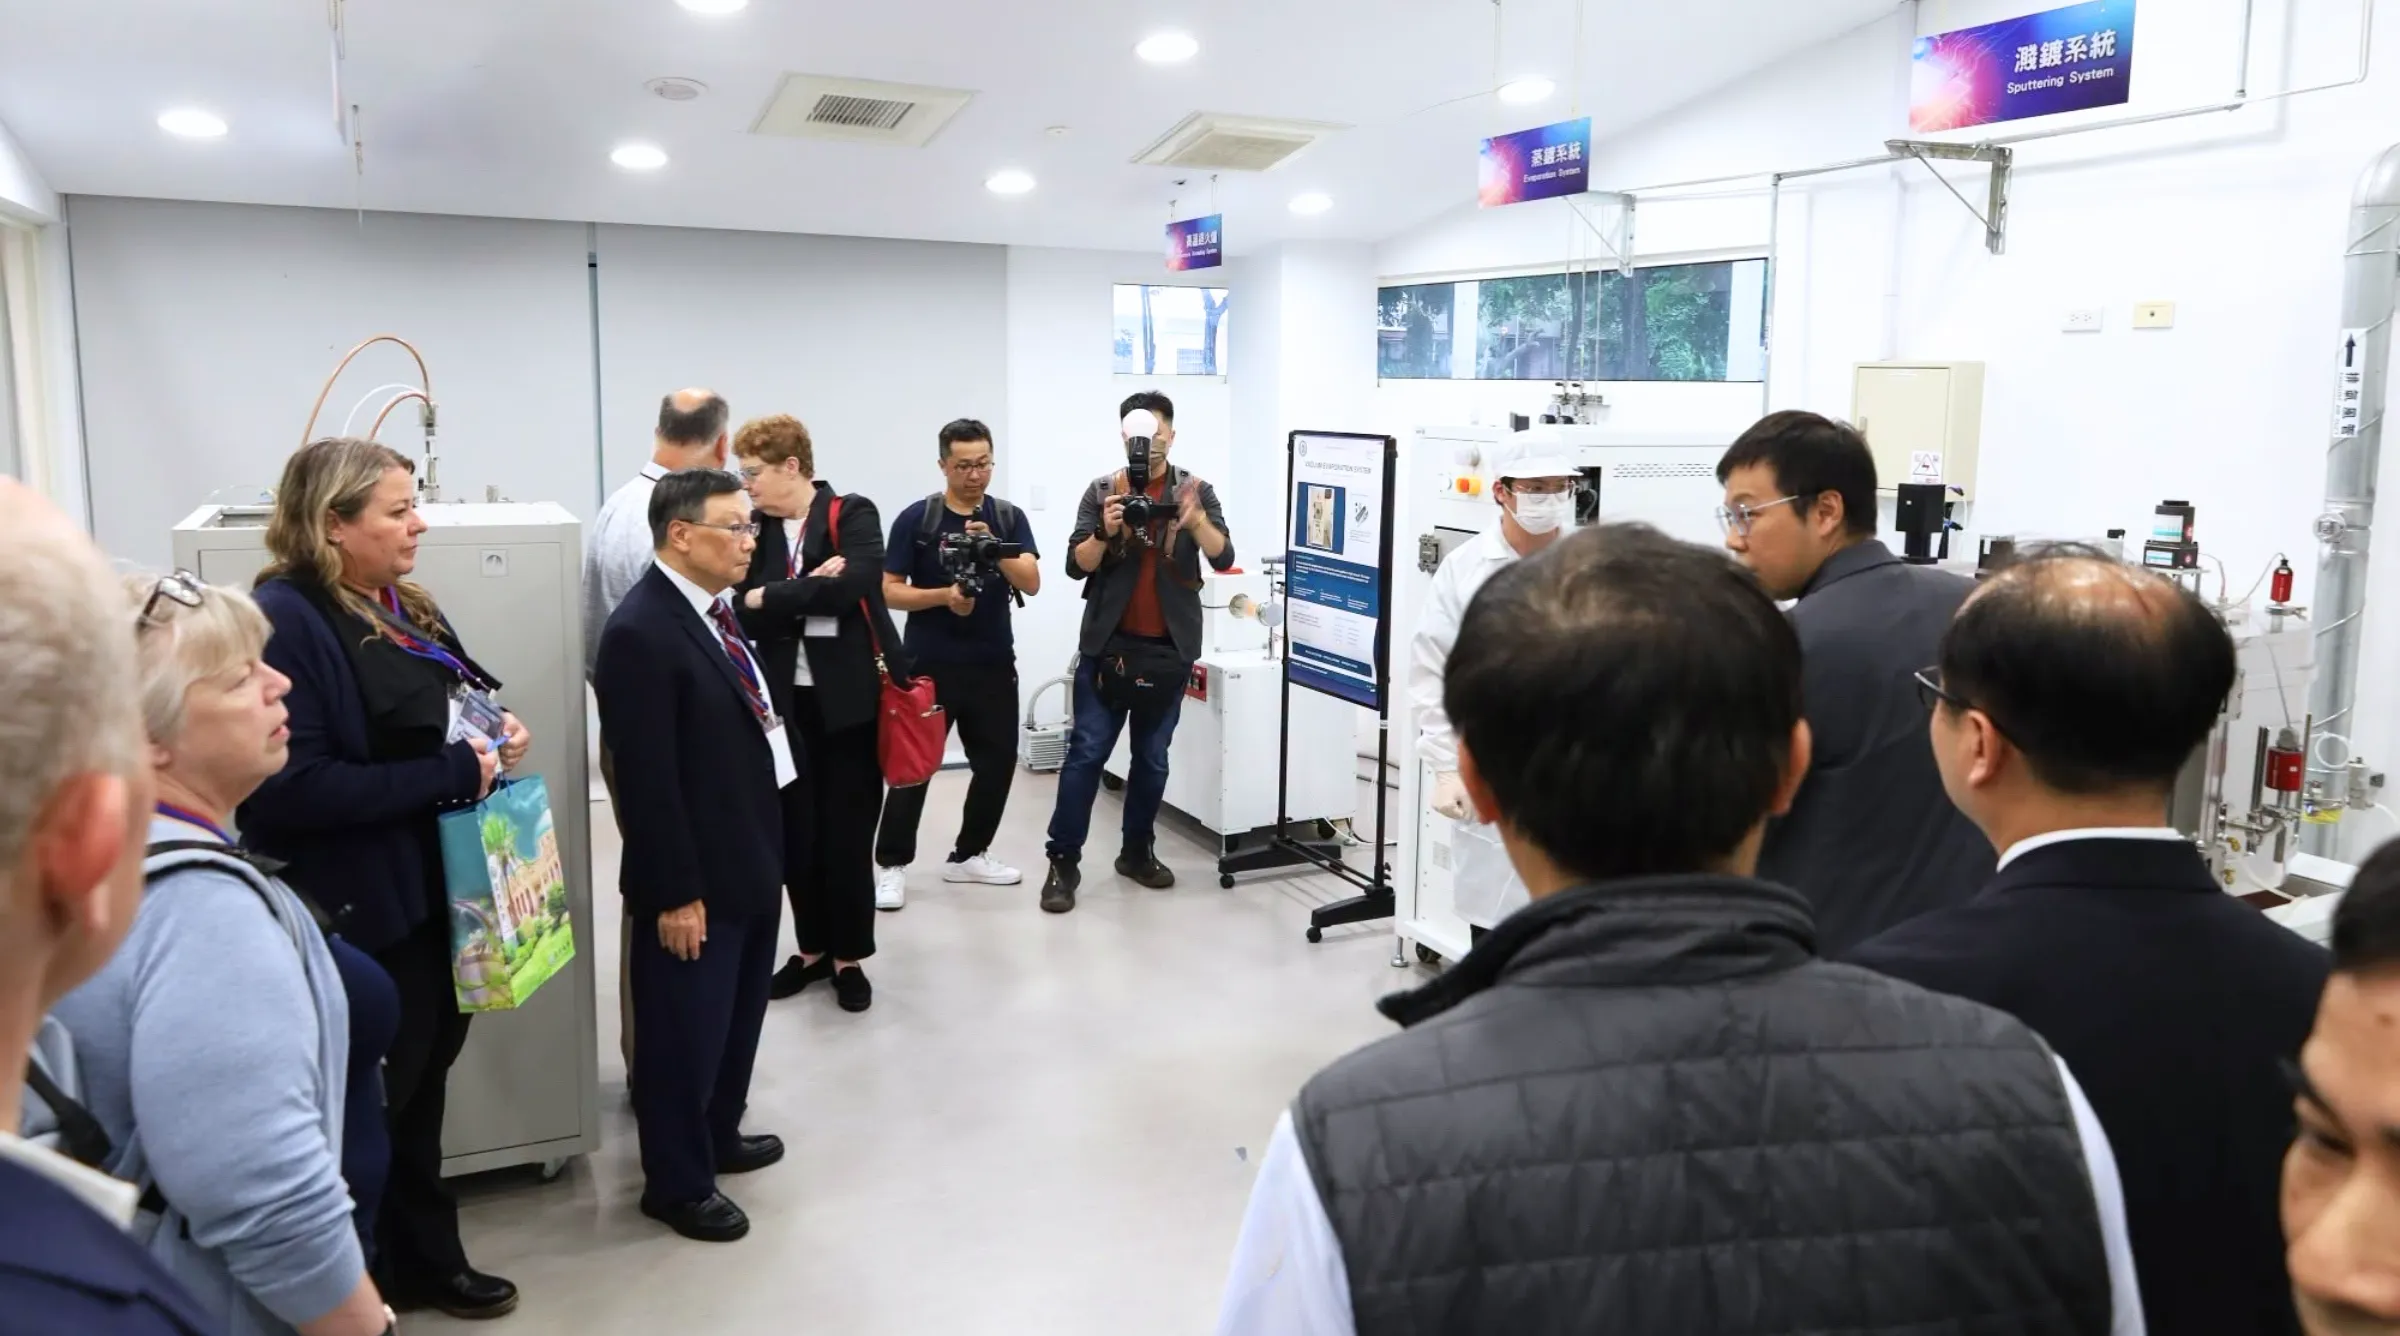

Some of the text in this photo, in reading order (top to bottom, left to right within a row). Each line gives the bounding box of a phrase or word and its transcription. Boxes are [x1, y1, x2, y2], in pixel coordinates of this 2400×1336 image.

[2014, 29, 2116, 73] 濺鍍系統
[2007, 67, 2114, 94] Sputtering System
[1531, 141, 1581, 168] 蒸鍍系統
[1523, 167, 1581, 183] Evaporation System
